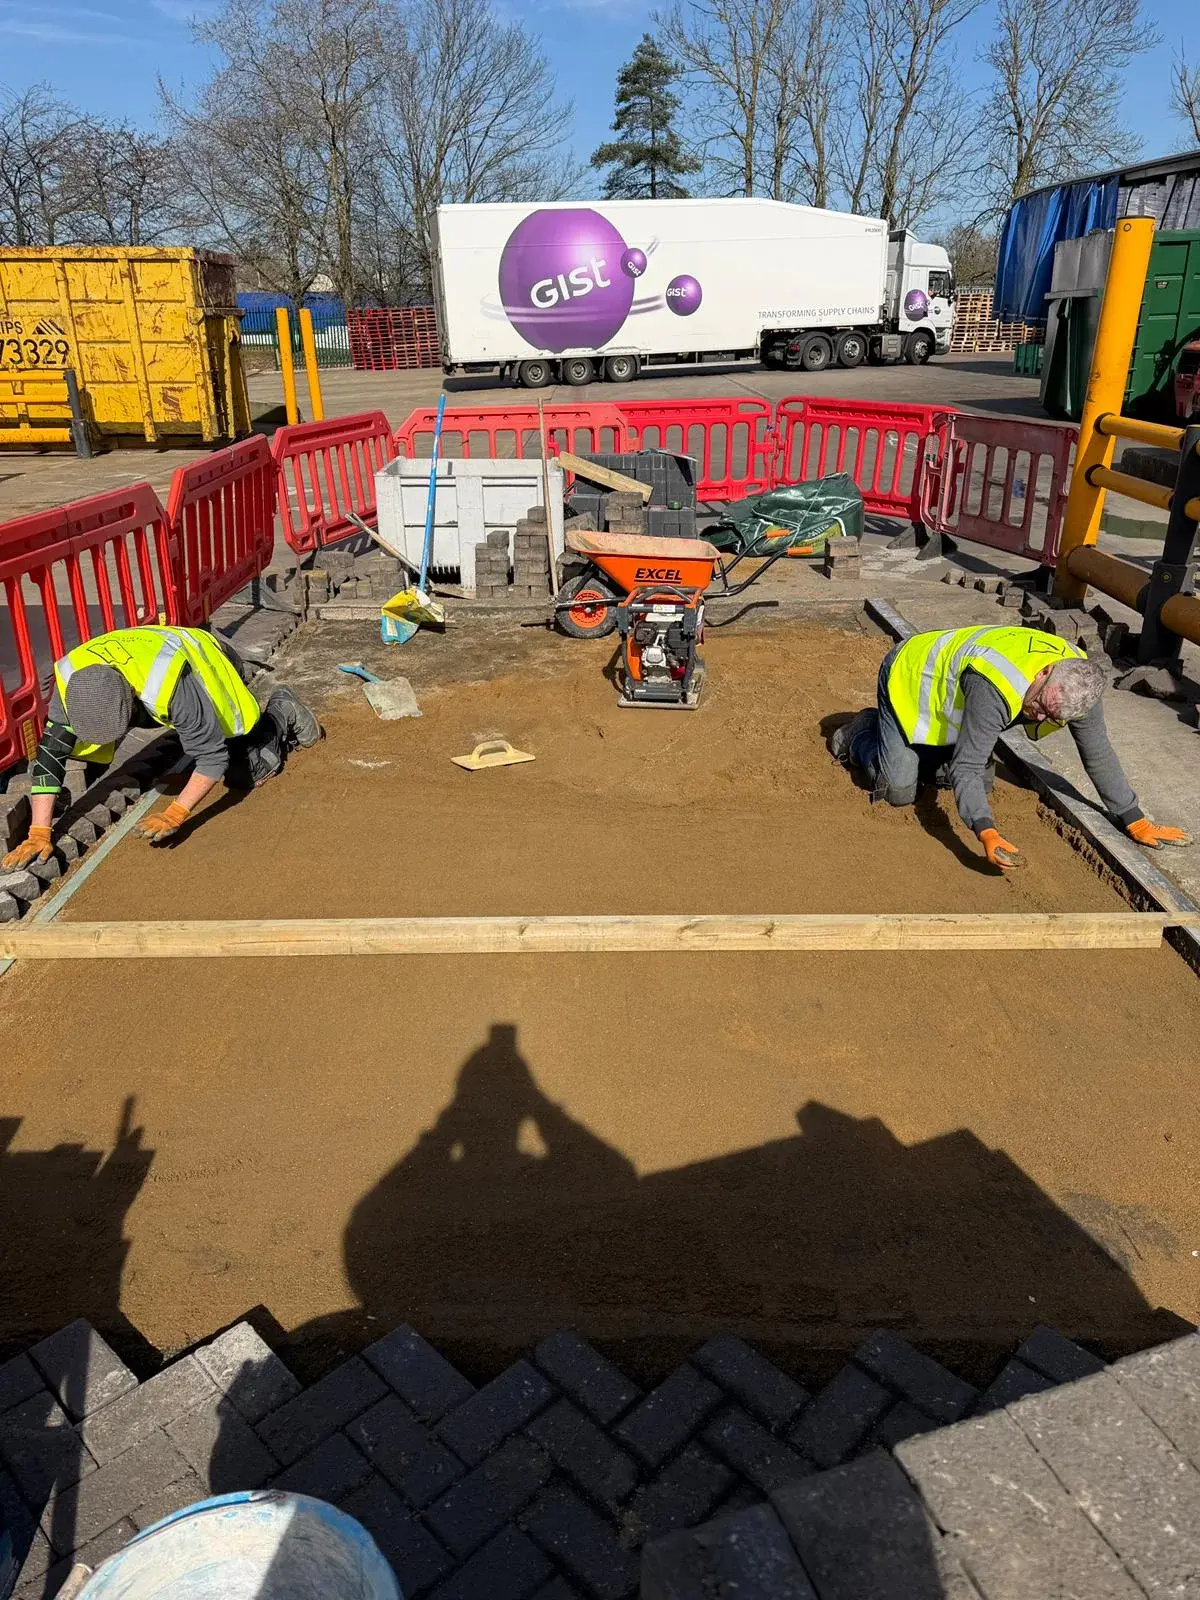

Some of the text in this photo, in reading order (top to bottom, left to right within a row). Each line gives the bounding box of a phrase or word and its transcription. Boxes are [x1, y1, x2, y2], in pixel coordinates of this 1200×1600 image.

[758, 306, 875, 319] TRANSFORMING SUPPLY CHAINS
[0, 321, 23, 335] IPS
[635, 567, 683, 580] EXCEL
